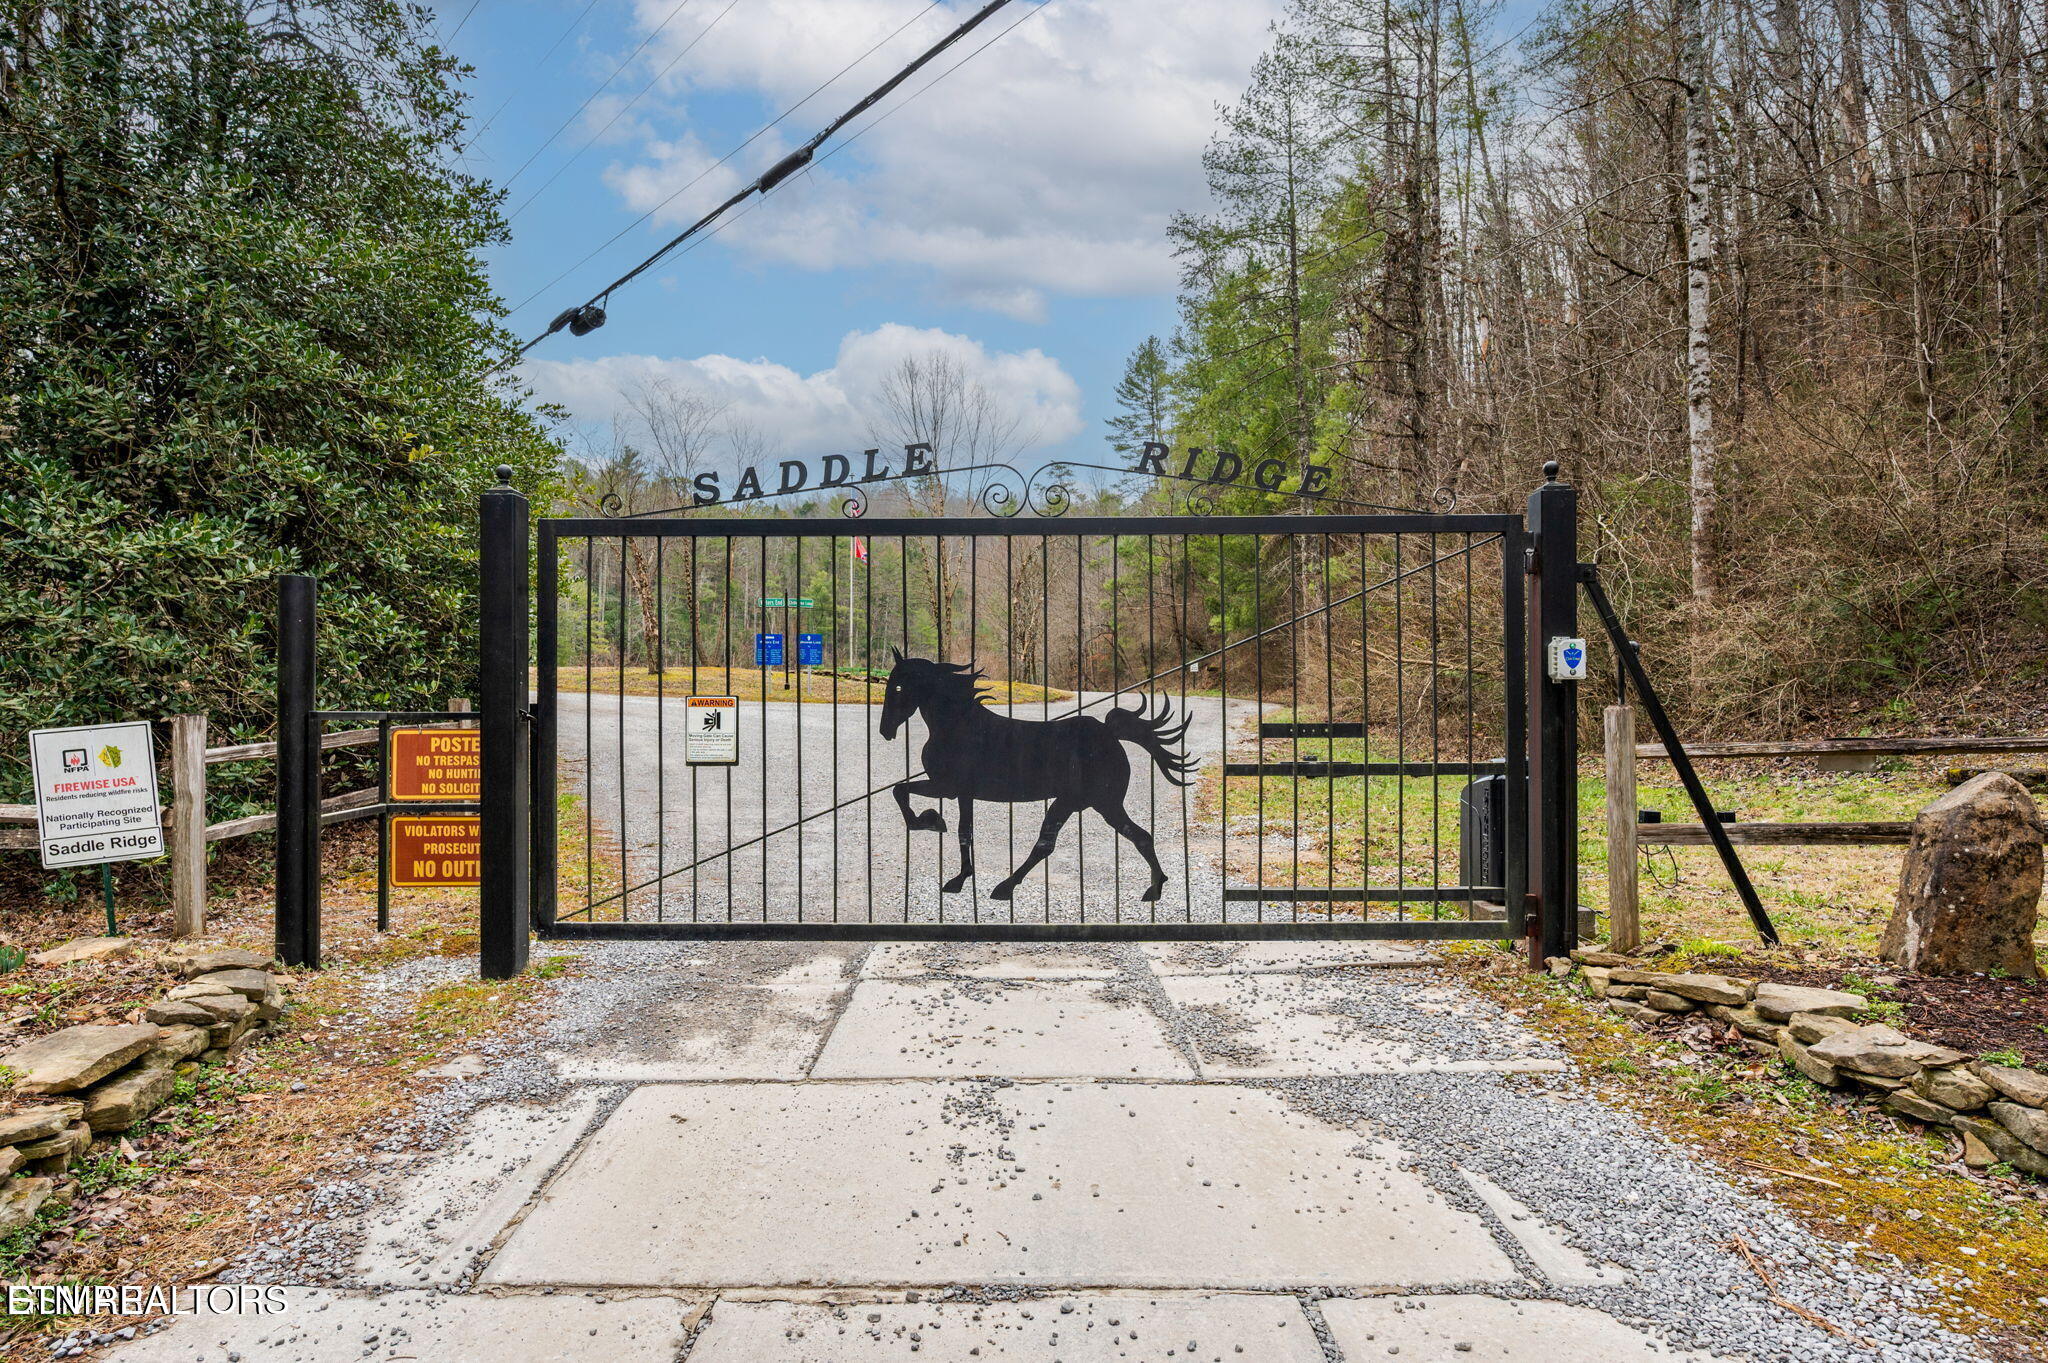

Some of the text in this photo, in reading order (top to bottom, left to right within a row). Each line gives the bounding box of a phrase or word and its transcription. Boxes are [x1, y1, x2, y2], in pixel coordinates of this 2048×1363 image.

[693, 441, 1333, 506] SADDLE RIDGE
[430, 737, 480, 752] POSTE
[416, 755, 480, 766] NO TRESPAS
[428, 768, 480, 779] NO HUNTI
[54, 780, 109, 794] FIREWISE
[421, 783, 480, 794] NO SOLICIT
[46, 794, 78, 802] Residents
[79, 791, 107, 799] reducing
[46, 805, 153, 822] Nationally Recognized
[60, 816, 142, 831] Participating Site
[404, 825, 465, 837] VIOLATORS
[49, 835, 157, 856] Saddle Ridge
[423, 843, 480, 854] PROSECUT
[413, 860, 436, 878] NO
